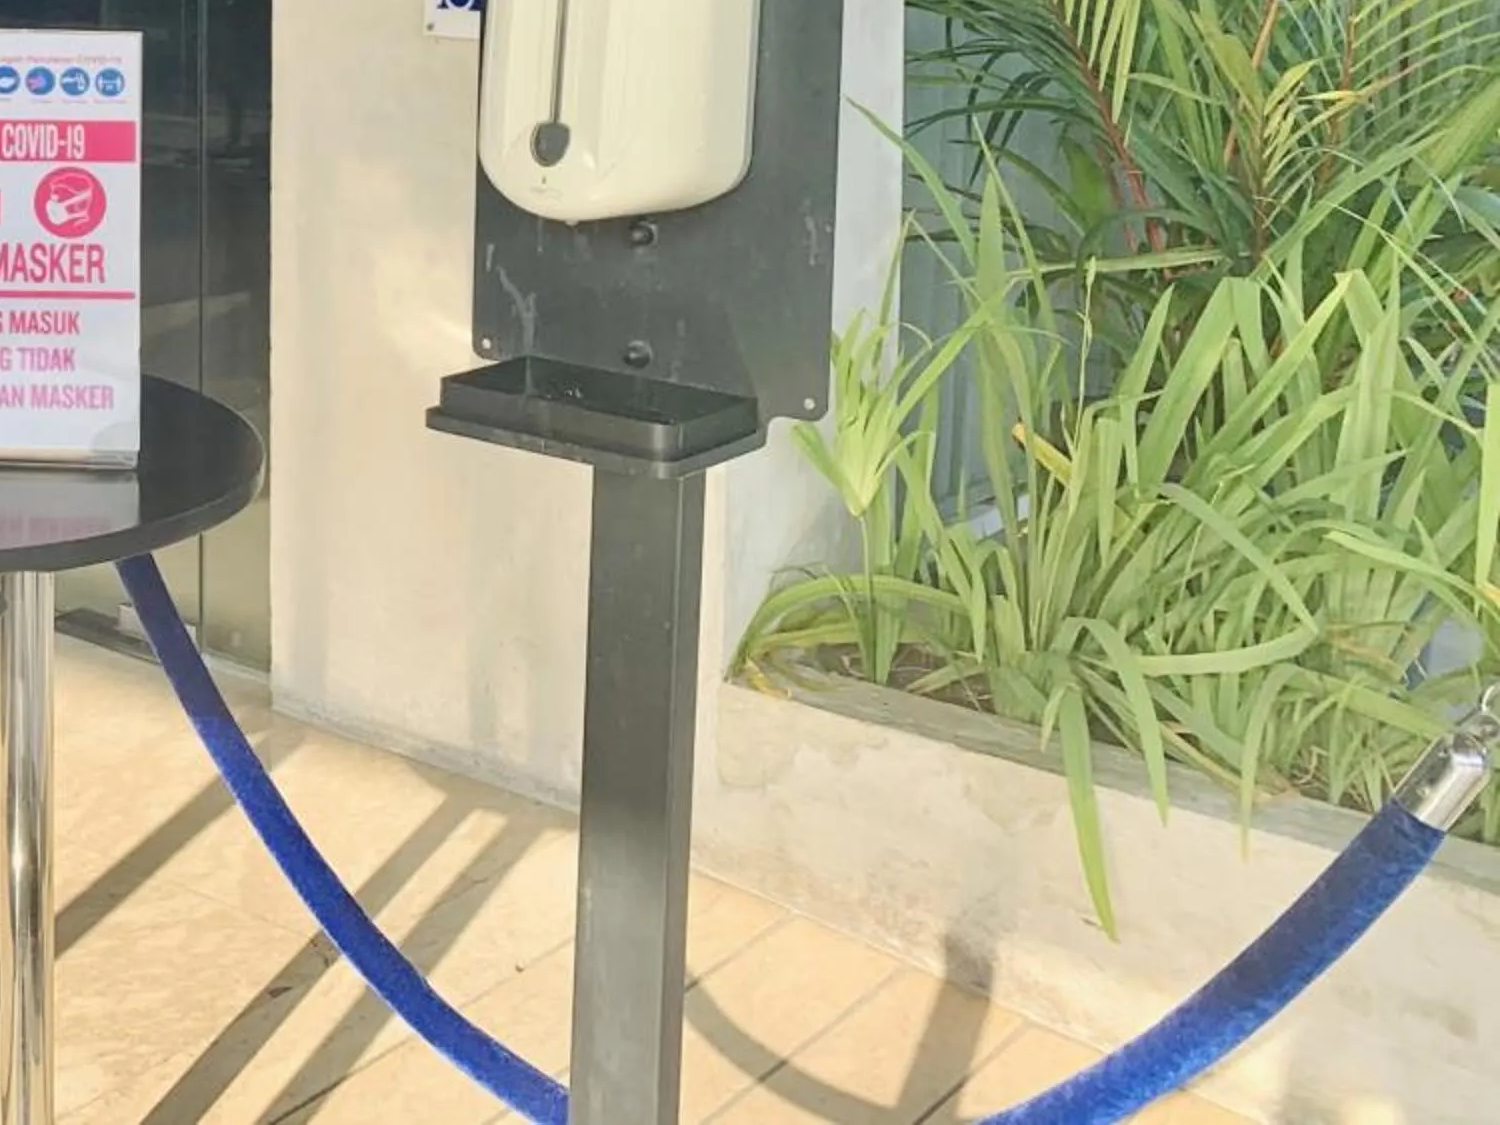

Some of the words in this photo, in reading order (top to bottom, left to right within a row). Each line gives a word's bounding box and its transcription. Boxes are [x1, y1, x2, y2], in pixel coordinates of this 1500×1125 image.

[2, 123, 85, 160] COVID-19
[8, 310, 81, 335] MASUK
[17, 347, 76, 373] TIDAK
[30, 384, 115, 411] MASKER
